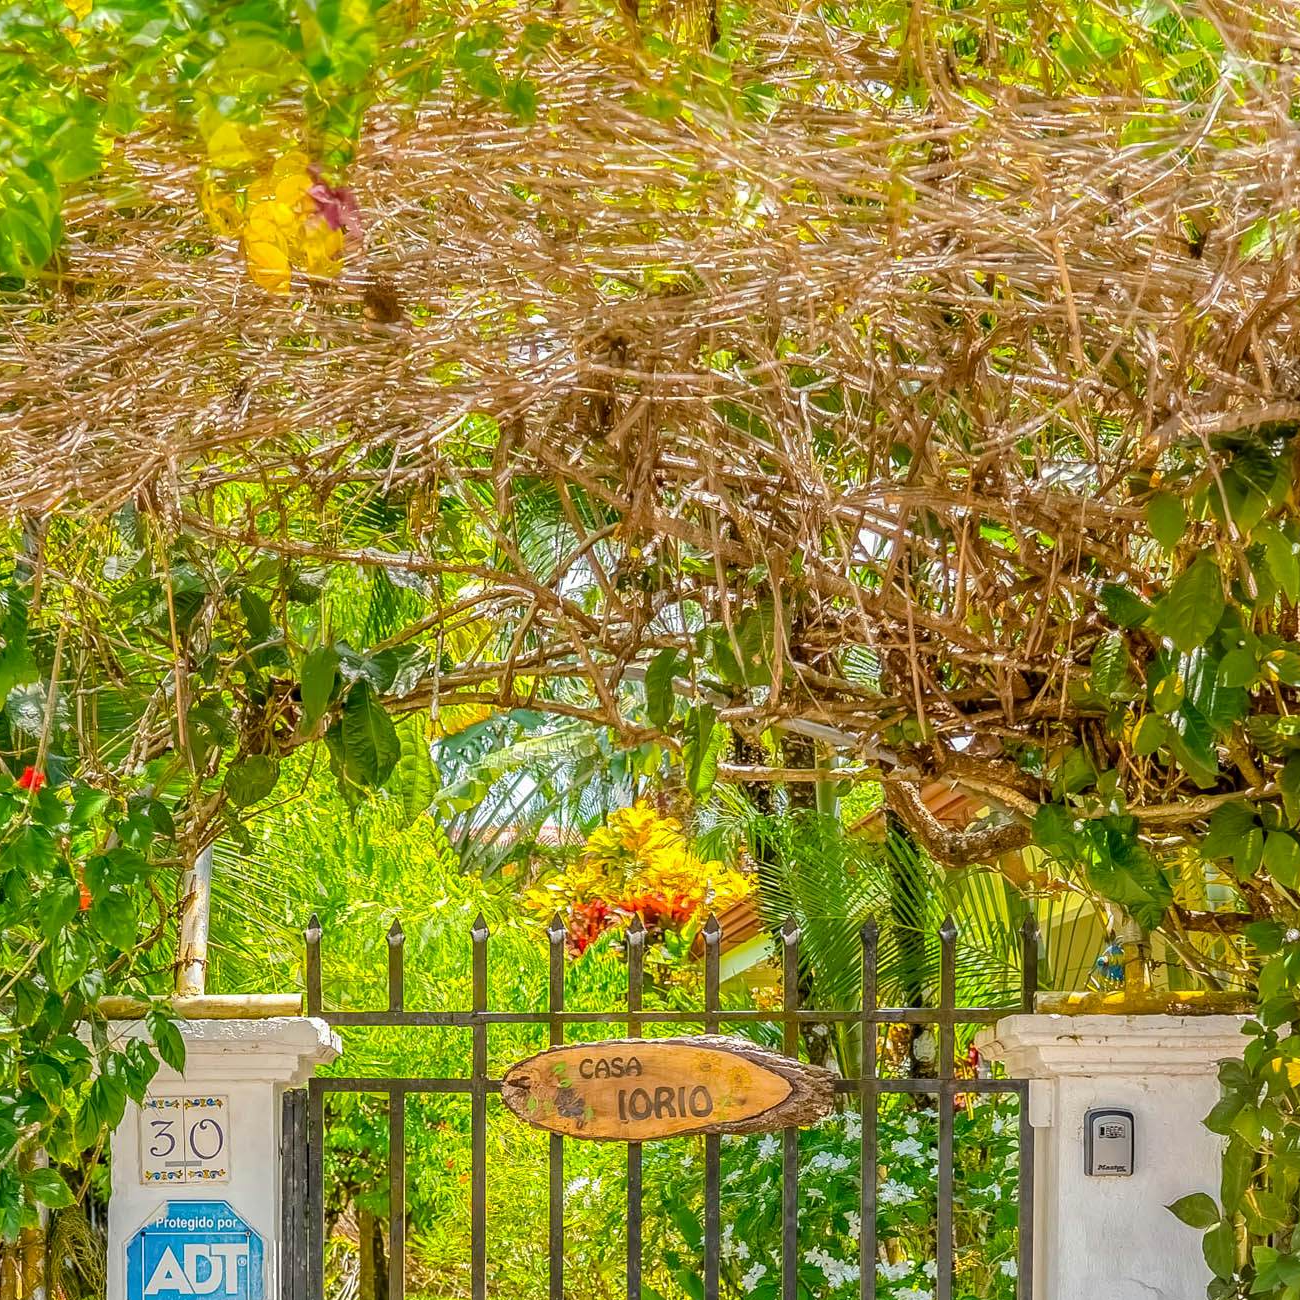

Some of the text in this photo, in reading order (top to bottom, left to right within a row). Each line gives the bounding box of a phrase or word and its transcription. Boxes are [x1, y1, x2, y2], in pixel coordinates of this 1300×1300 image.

[579, 1056, 643, 1079] CASA
[618, 1085, 714, 1121] IORIO
[150, 1119, 223, 1159] 30
[156, 1216, 238, 1231] Protegido por
[144, 1243, 248, 1295] ADT
